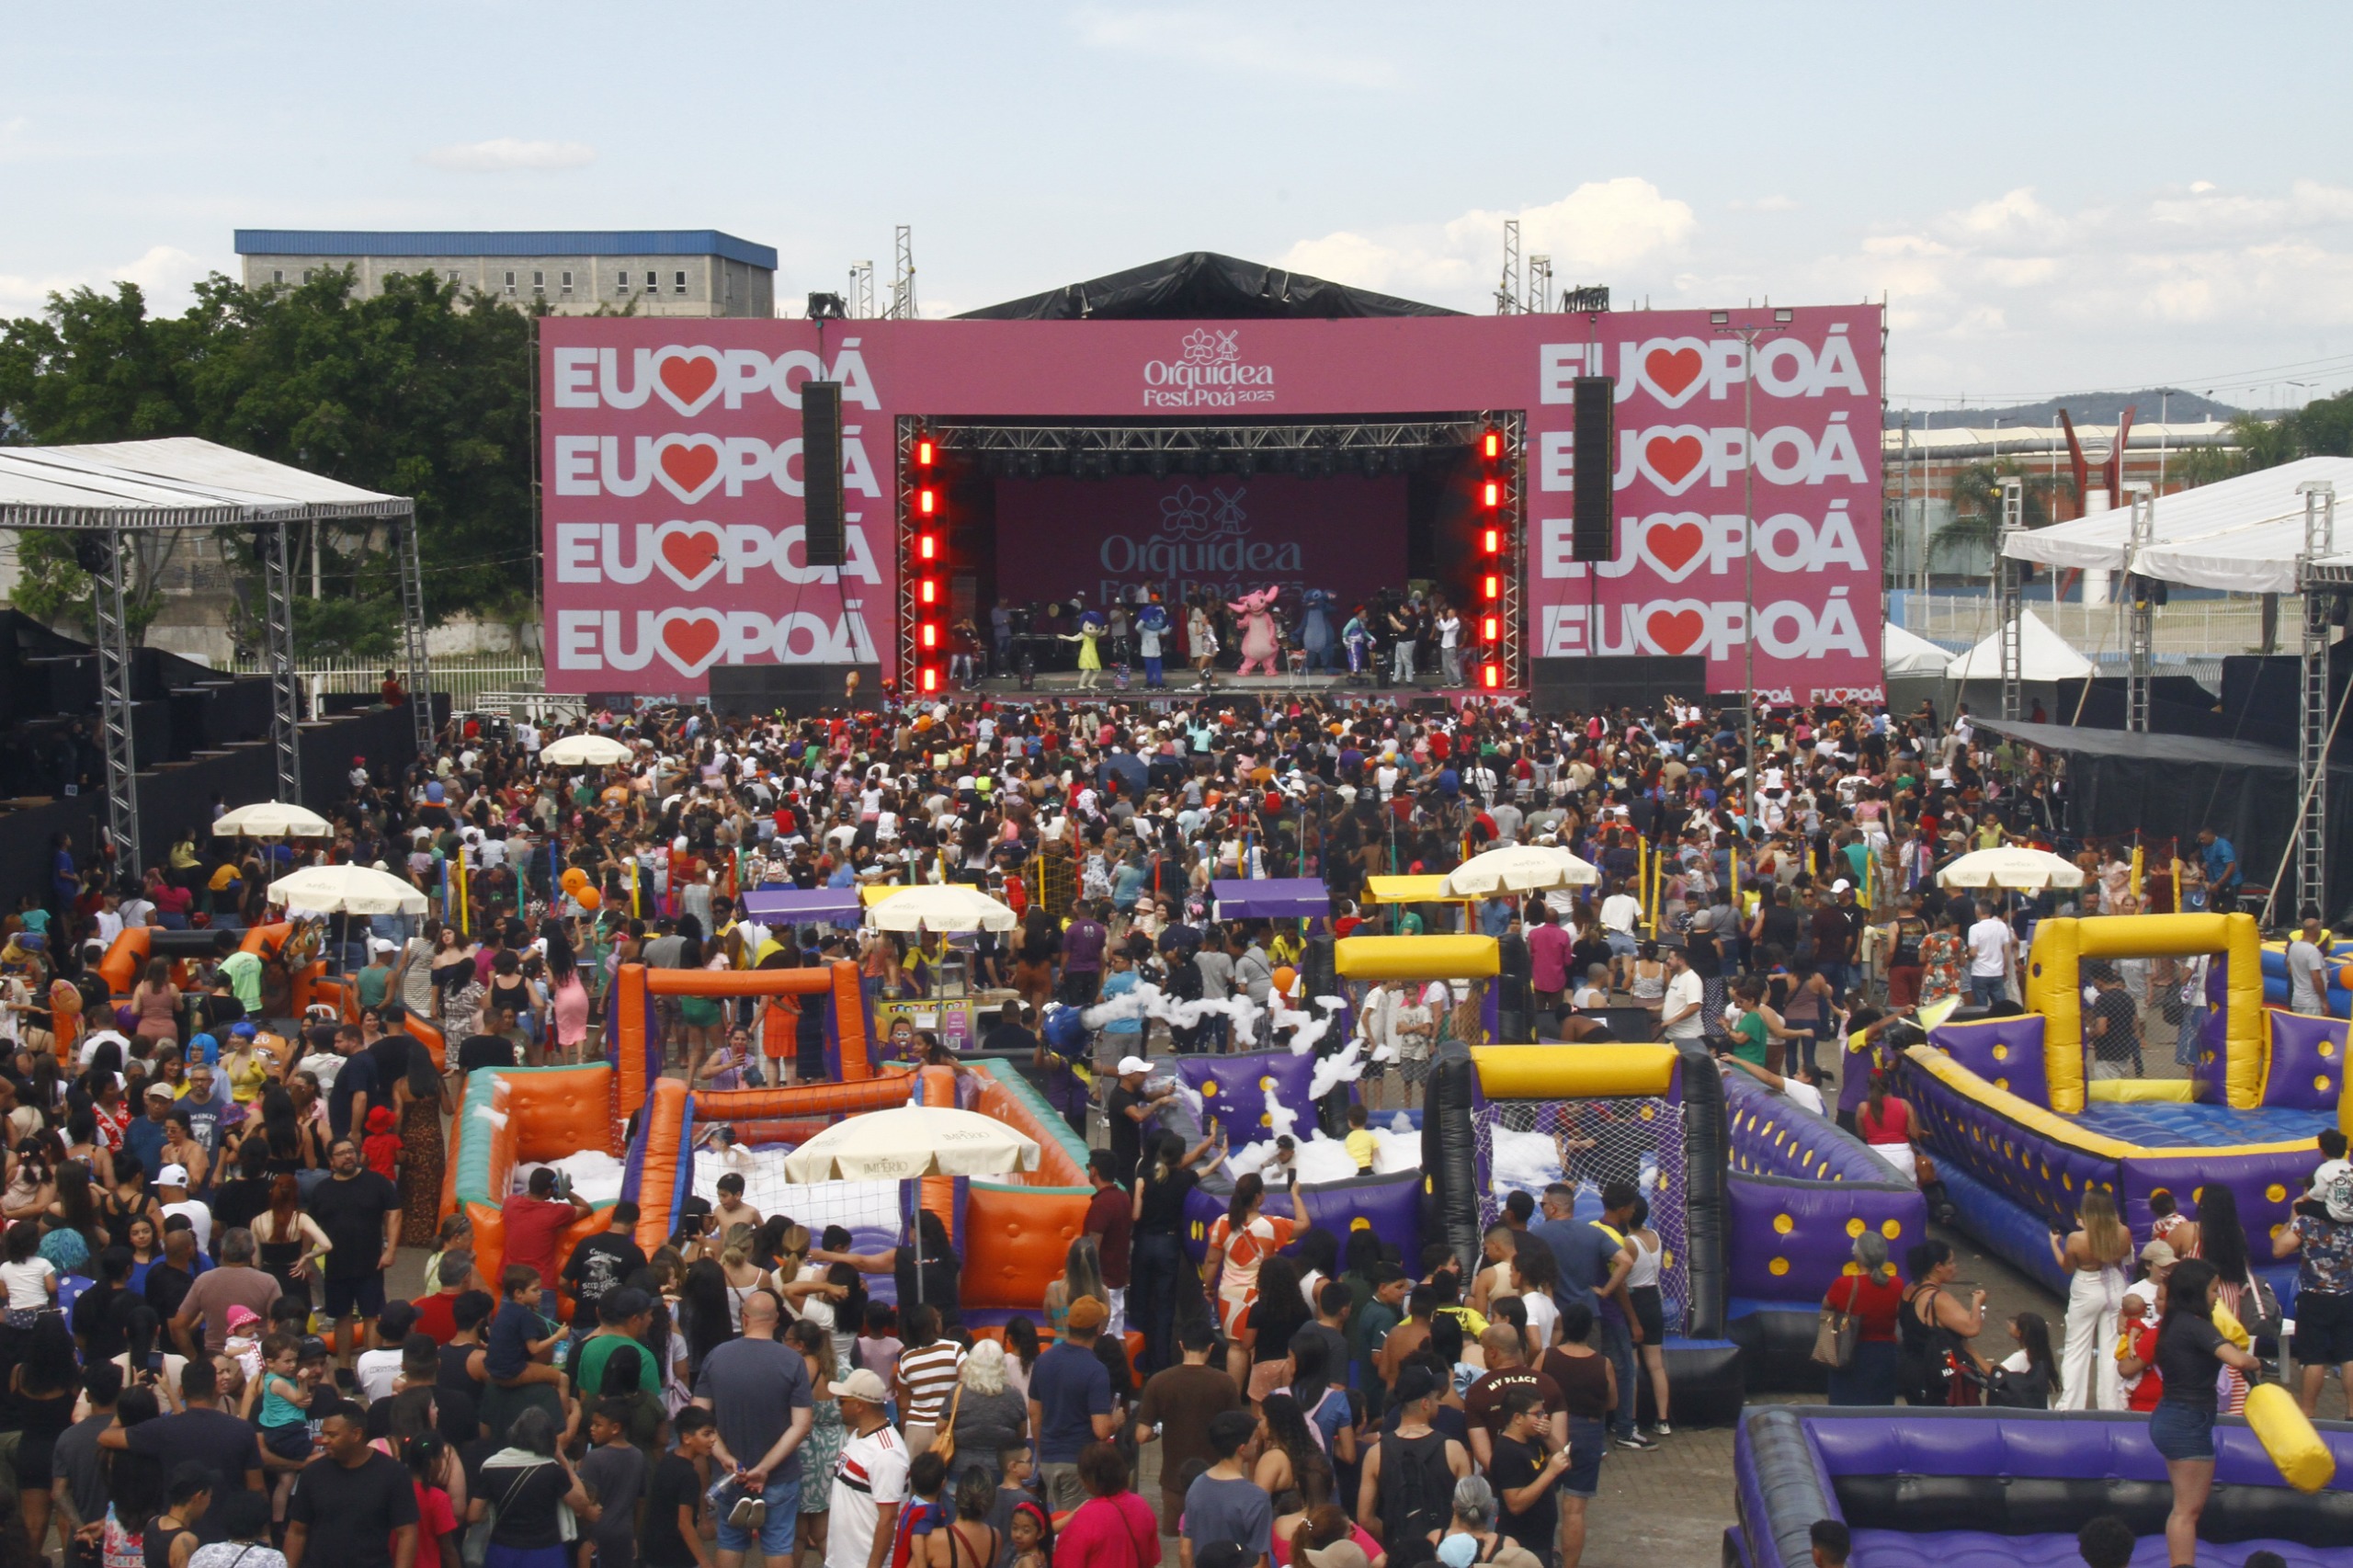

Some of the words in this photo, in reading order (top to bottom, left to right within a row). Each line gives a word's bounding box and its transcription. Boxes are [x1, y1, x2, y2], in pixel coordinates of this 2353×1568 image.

[1143, 360, 1274, 390] Orquídea
[1238, 391, 1275, 402] 2025
[1099, 534, 1303, 579] Orquídea
[1488, 1379, 1502, 1391] MY
[1504, 1375, 1538, 1385] PLACE
